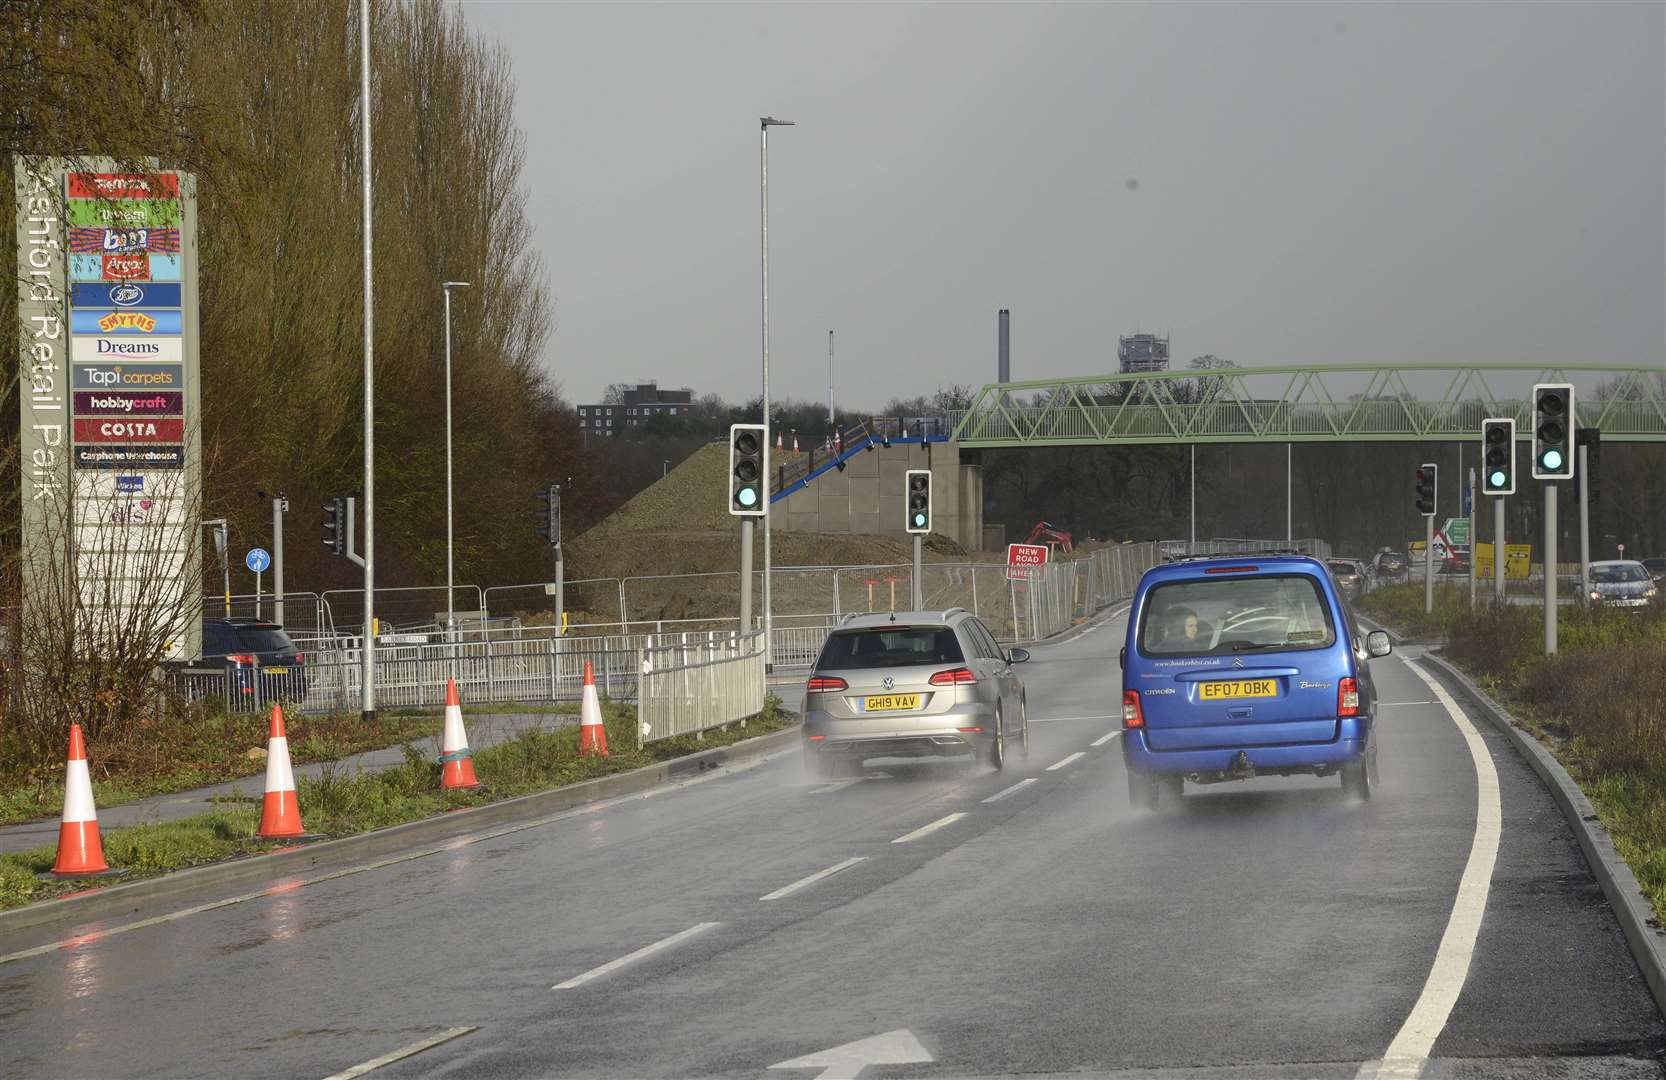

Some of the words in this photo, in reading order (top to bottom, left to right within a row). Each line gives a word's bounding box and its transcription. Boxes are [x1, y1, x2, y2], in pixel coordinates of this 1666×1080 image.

[28, 170, 58, 302] Ashford
[106, 257, 145, 272] Argos
[99, 314, 156, 331] SMYTHS
[97, 339, 159, 353] Dreams
[31, 316, 61, 410] Retail
[84, 367, 121, 386] Tapi
[123, 372, 173, 385] carpets
[91, 396, 167, 412] hobbycraft
[101, 423, 157, 436] COSTA
[32, 424, 62, 501] Park
[80, 451, 125, 461] Carphone
[126, 451, 178, 461] Warehouse
[1015, 555, 1039, 563] ROAD
[1018, 548, 1038, 556] NEW
[1204, 683, 1240, 696] EF07
[1243, 681, 1271, 694] OBK
[868, 698, 892, 709] GH19
[895, 696, 915, 707] VAV
